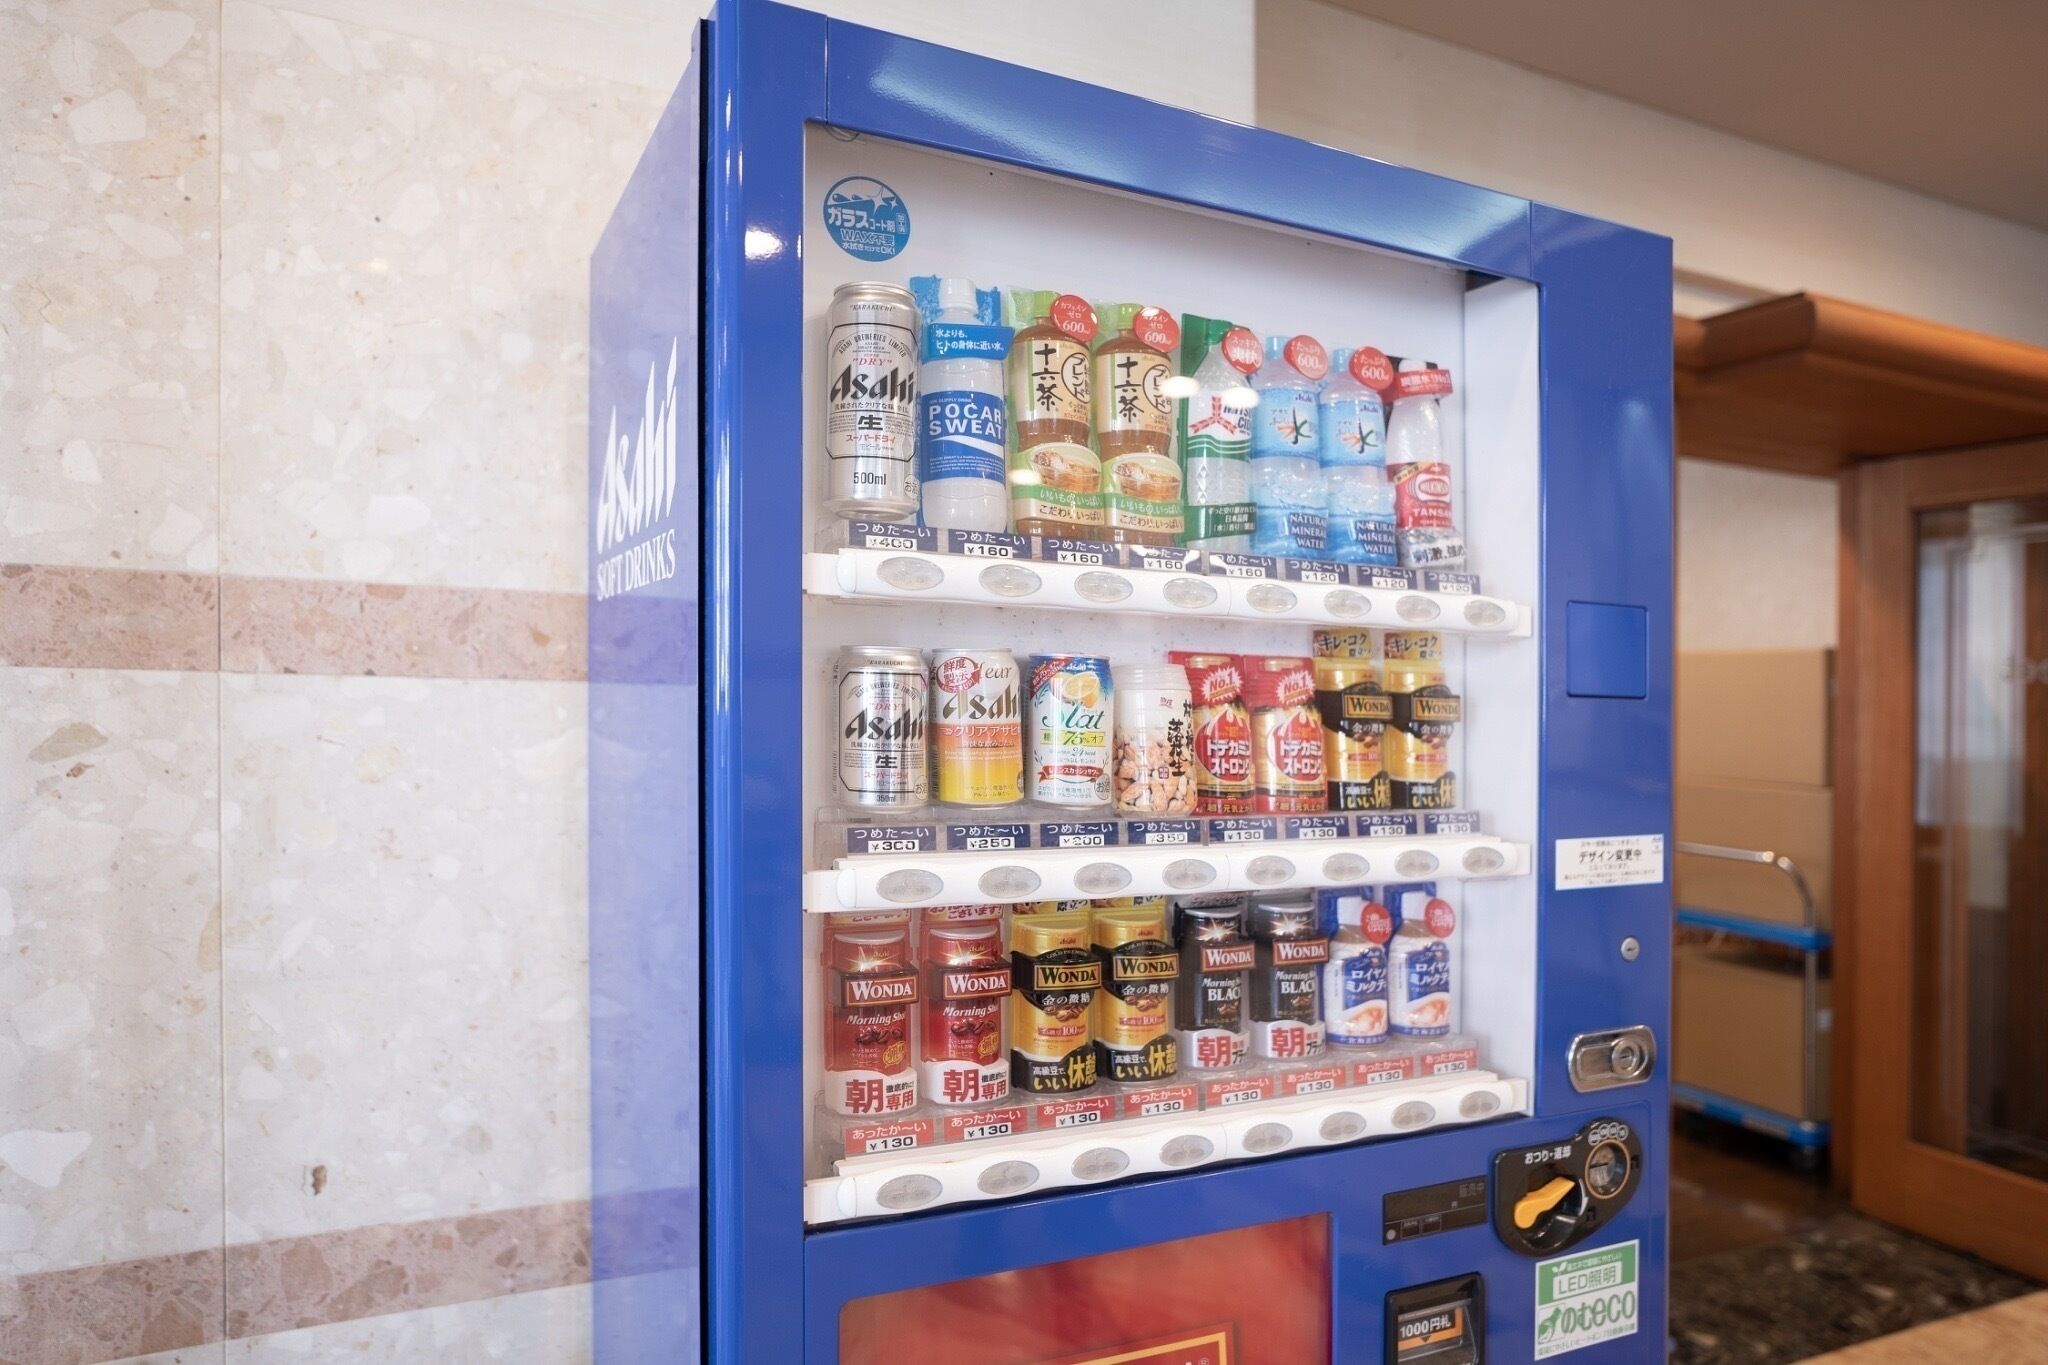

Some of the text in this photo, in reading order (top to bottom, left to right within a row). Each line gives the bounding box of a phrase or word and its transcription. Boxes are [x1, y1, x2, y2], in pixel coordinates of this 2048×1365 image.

[840, 228, 895, 246] WAX不要
[1061, 302, 1087, 311] カフェイン
[1067, 312, 1082, 320] ゼロ
[936, 329, 968, 338] 水よりも、
[936, 340, 1005, 352] ヒトの身体に近い水。
[1031, 343, 1064, 412] 十六茶
[1071, 355, 1086, 398] ブレンド
[830, 364, 914, 405] Asahi
[1114, 356, 1144, 422] 十六茶
[858, 414, 884, 431] 生
[929, 418, 1002, 440] SWEAT
[597, 336, 676, 555] Asahi
[846, 434, 896, 444] スーパードライ
[853, 472, 887, 485] 500ml
[855, 522, 931, 538] つめた〜い
[871, 537, 914, 549] ¥400
[955, 531, 1026, 546] つめた〜い
[1296, 537, 1326, 549] WATER
[967, 546, 1009, 557] ¥160
[1048, 539, 1114, 553] つめた〜い
[1363, 543, 1393, 555] WATER
[597, 528, 676, 601] SOFT DRINKS
[1060, 553, 1099, 564] ¥160
[1147, 560, 1184, 570] ¥160
[1229, 568, 1263, 577] ¥160
[1289, 561, 1344, 573] つめた〜い
[1361, 566, 1413, 578] つめた〜い
[1305, 573, 1337, 582] ¥120
[1375, 579, 1406, 589] ¥120
[1319, 633, 1367, 650] キレ・コク
[1392, 636, 1438, 652] キレ・コク
[845, 707, 923, 740] Asahi
[1044, 731, 1104, 746] 糖75%オフ
[875, 754, 898, 769] 生
[1049, 766, 1100, 776] レンスカッシュサワー
[876, 794, 896, 803] 350ml
[1134, 821, 1196, 832] つめた〜い
[1215, 819, 1272, 829] つめた〜い
[1290, 816, 1345, 827] つめた〜い
[1360, 815, 1413, 825] つめた〜い
[854, 828, 929, 839] つめた〜い
[954, 826, 1024, 837] つめた〜い
[1047, 823, 1113, 834] つめた〜い
[1227, 831, 1261, 840] ¥130
[1302, 828, 1335, 838] ¥130
[1373, 825, 1404, 835] ¥130
[872, 841, 916, 851] ¥300
[970, 838, 1011, 848] ¥250
[1063, 837, 1102, 845] ¥200
[1579, 848, 1642, 864] デザイン変更中
[1206, 949, 1252, 967] WONDA
[1277, 942, 1325, 960] WONDA
[1119, 957, 1175, 975] WONDA
[1040, 967, 1097, 985] WONDA
[851, 980, 912, 1000] WONDA
[949, 974, 1007, 994] WONDA
[1122, 983, 1169, 996] 金の微糖
[1042, 992, 1091, 1006] 金の微糖
[943, 1004, 986, 1017] Morning
[847, 1012, 892, 1026] Morning
[1271, 1026, 1305, 1058] 朝
[1198, 1036, 1232, 1068] 朝
[1115, 1043, 1177, 1078] いい休憩
[1359, 1059, 1410, 1072] あったか〜い
[1436, 1062, 1465, 1073] ¥130
[1033, 1053, 1097, 1090] いい休憩
[1287, 1068, 1342, 1082] あったか〜い
[1370, 1071, 1400, 1082] ¥130
[943, 1069, 980, 1103] 朝
[981, 1079, 1007, 1100] 専用
[1212, 1078, 1269, 1093] あったか〜い
[1299, 1081, 1331, 1093] ¥130
[845, 1078, 884, 1114] 朝
[886, 1090, 914, 1111] 専用
[1130, 1088, 1192, 1103] あったか〜い
[1224, 1091, 1259, 1103] ¥130
[1043, 1099, 1109, 1115] あったか〜い
[1145, 1101, 1181, 1114] ¥130
[952, 1111, 1021, 1127] あったか〜い
[1059, 1112, 1098, 1126] ¥130
[852, 1122, 927, 1140] あったか〜い
[967, 1125, 1009, 1137] ¥130
[870, 1136, 914, 1150] ¥130
[1558, 1265, 1617, 1295] LED照明
[1400, 1314, 1452, 1338] 1000円札
